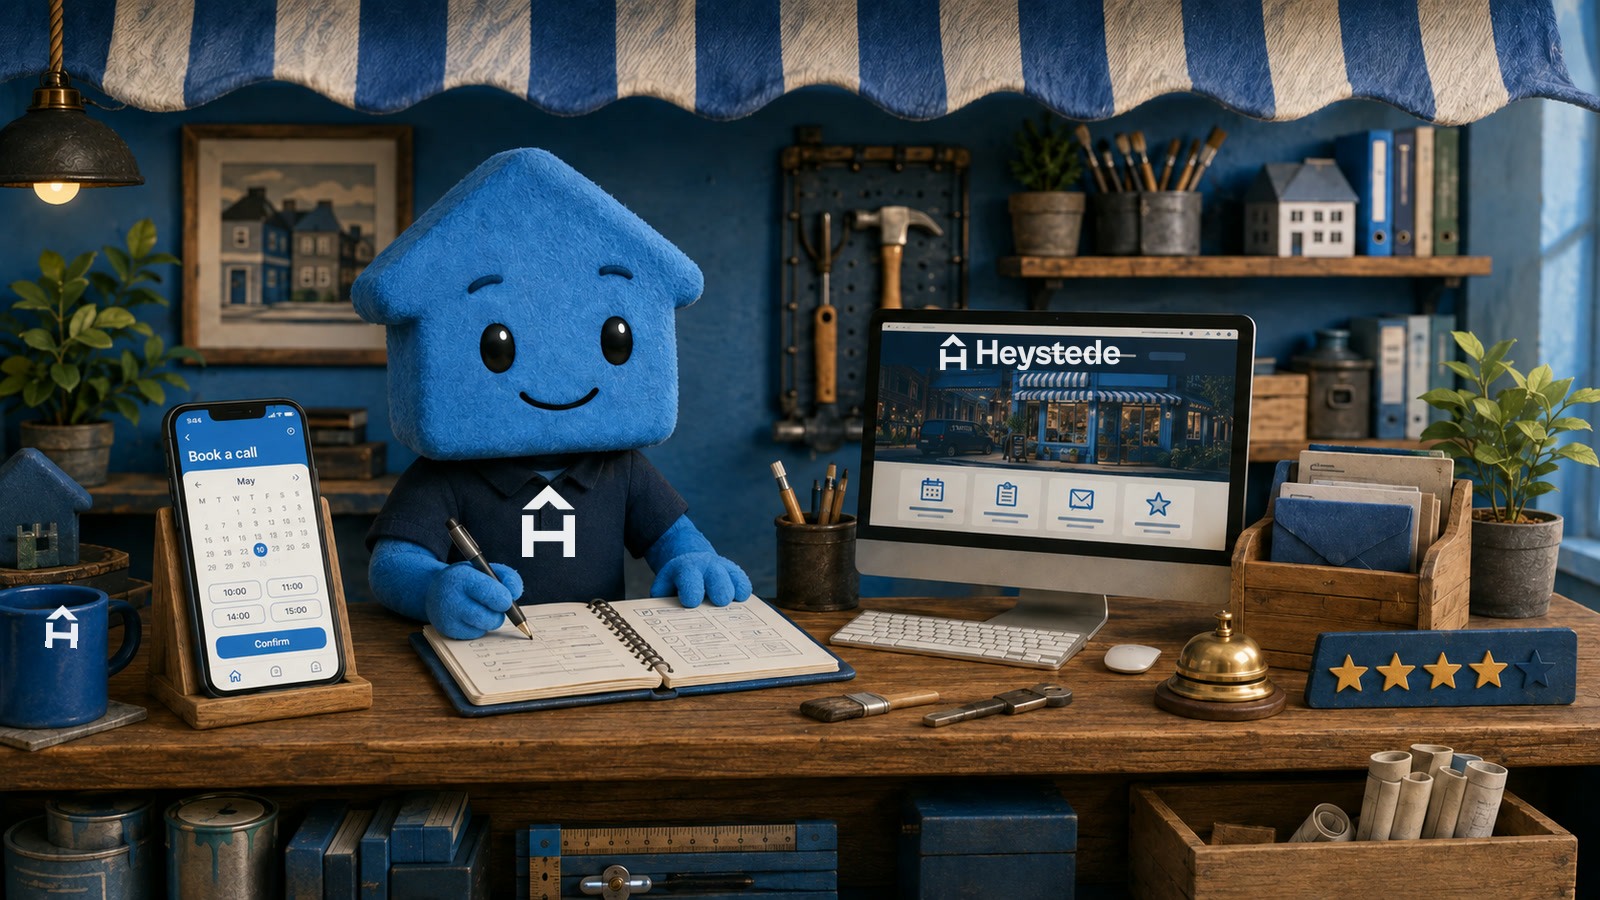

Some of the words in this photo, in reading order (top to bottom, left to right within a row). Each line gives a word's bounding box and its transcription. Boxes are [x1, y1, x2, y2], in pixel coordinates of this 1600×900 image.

[976, 339, 1121, 371] Heystede
[188, 448, 222, 462] Book
[224, 450, 233, 460] a
[235, 446, 258, 459] call
[236, 477, 256, 487] May
[279, 491, 286, 499] S
[256, 546, 265, 554] 10
[222, 587, 247, 597] 10:00
[281, 582, 303, 592] 11:00
[285, 606, 308, 615] 15:00
[226, 611, 250, 621] 14:00
[254, 638, 290, 649] Confirm
